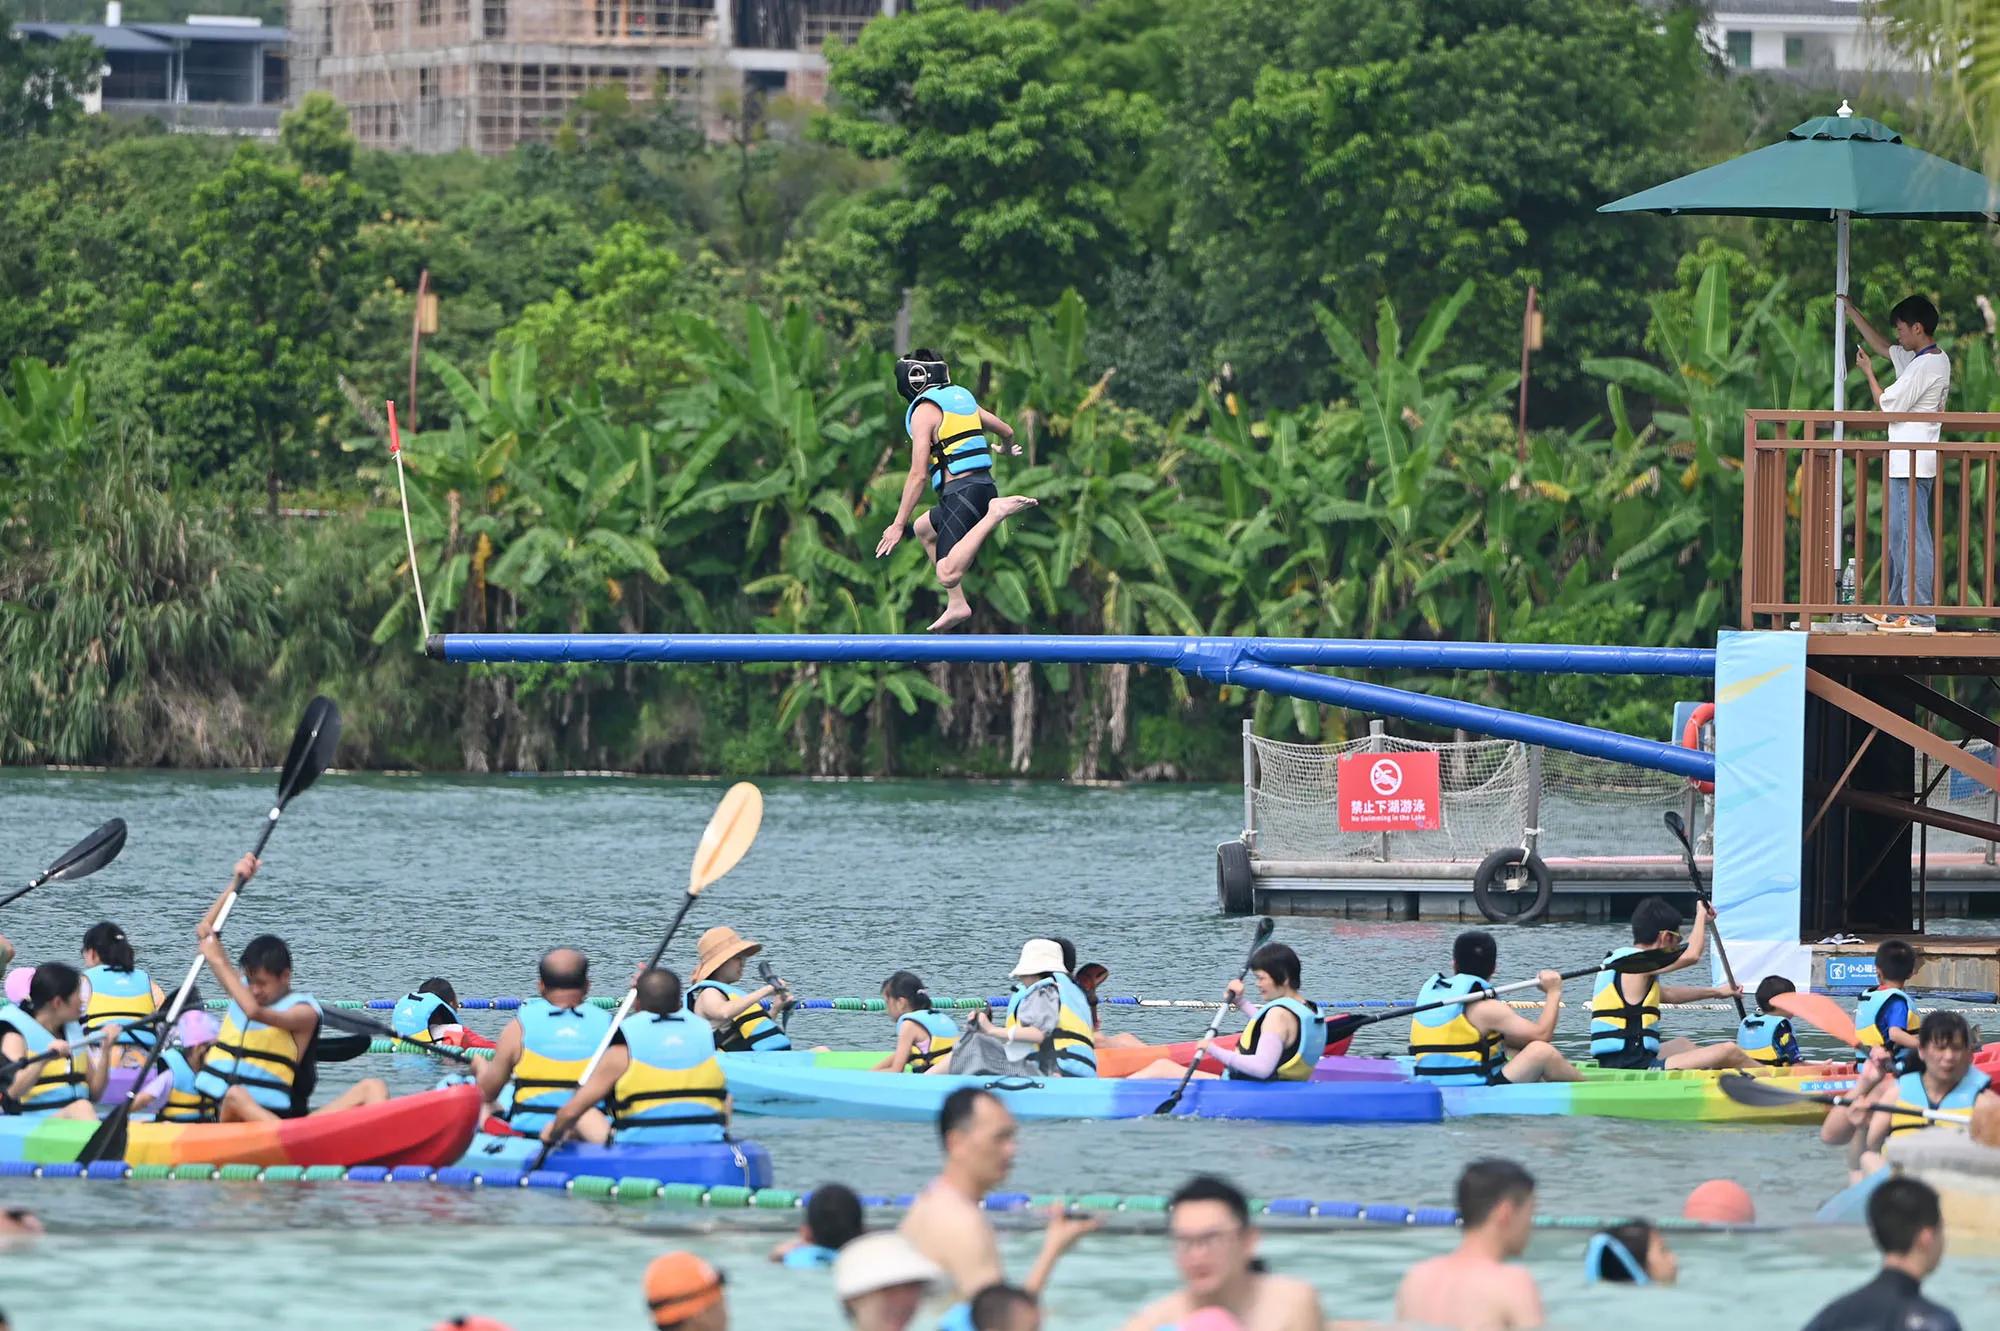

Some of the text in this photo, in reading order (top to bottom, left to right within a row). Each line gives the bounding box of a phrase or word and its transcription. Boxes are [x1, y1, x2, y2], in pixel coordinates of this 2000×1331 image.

[1351, 799, 1426, 814] 禁止下湖游泳
[1360, 815, 1391, 823] Swimming
